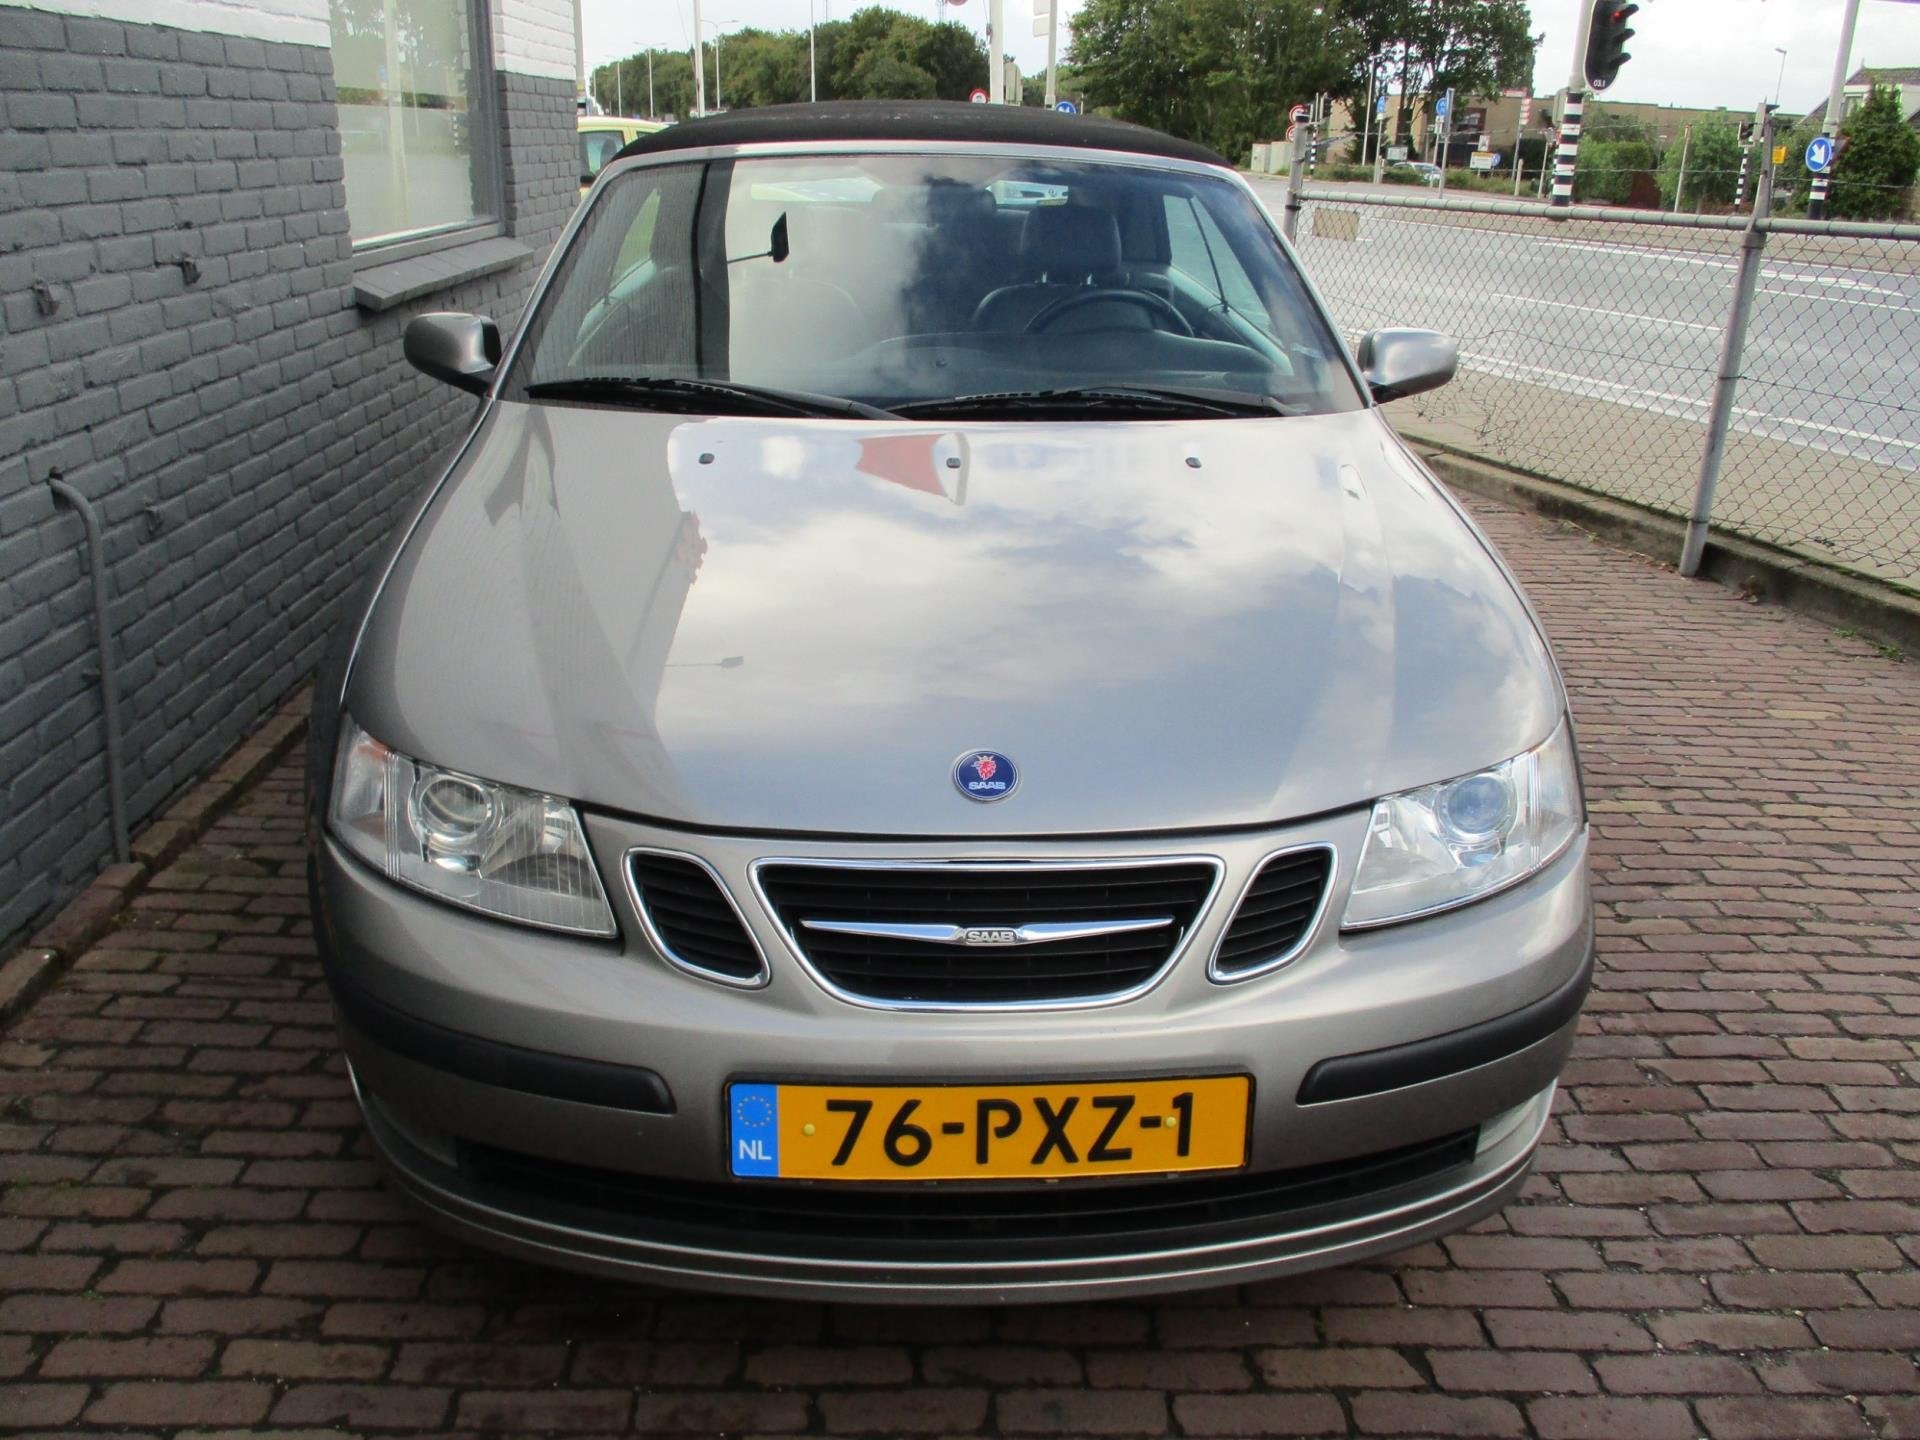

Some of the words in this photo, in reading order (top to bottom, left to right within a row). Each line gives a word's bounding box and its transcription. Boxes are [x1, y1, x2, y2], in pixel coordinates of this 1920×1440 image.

[968, 781, 1006, 790] SAAB
[967, 931, 1014, 942] SAAB
[825, 1091, 1194, 1167] 76-PXZ-1
[739, 1139, 772, 1161] NL
